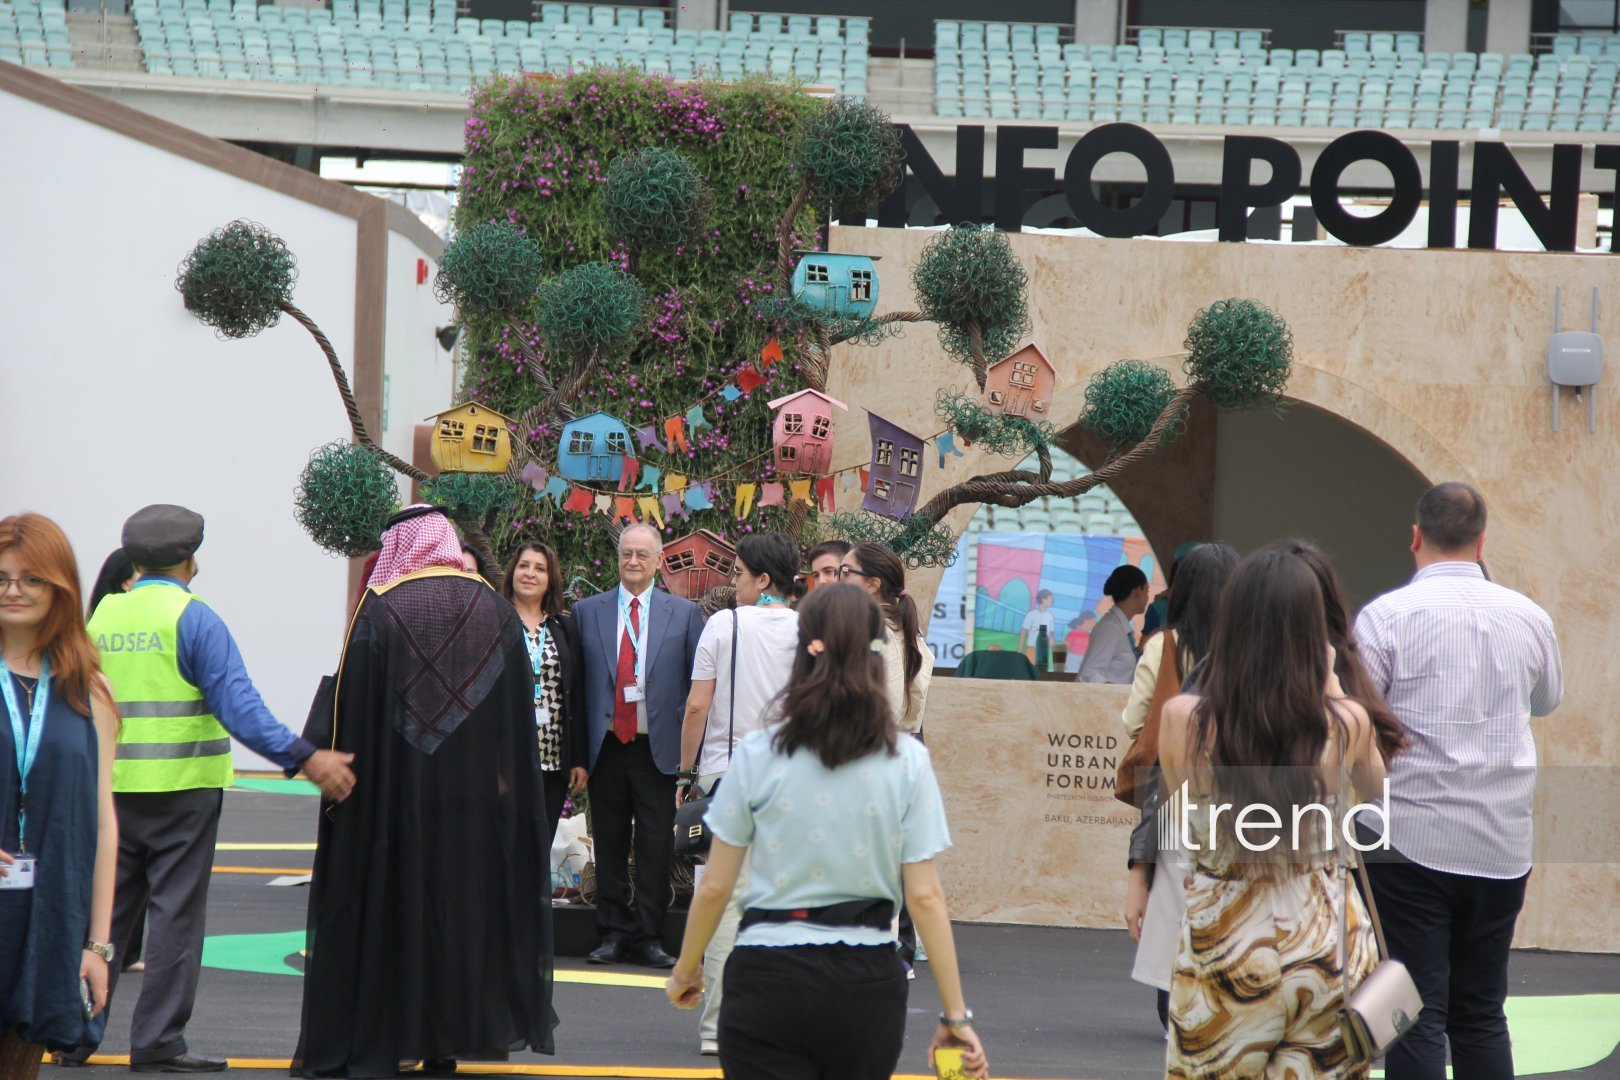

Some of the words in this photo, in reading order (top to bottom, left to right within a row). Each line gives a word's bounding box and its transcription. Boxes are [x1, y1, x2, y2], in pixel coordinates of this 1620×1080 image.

[838, 122, 1175, 239] NFO
[95, 631, 164, 652] ADSEA
[1047, 733, 1118, 750] WORLD
[1047, 753, 1117, 770] URBAN
[1046, 774, 1116, 790] FORUM
[1046, 793, 1086, 802] THIRTEENTH
[1044, 814, 1072, 825] BAKU,
[1075, 815, 1133, 828] AZERBAIJAN
